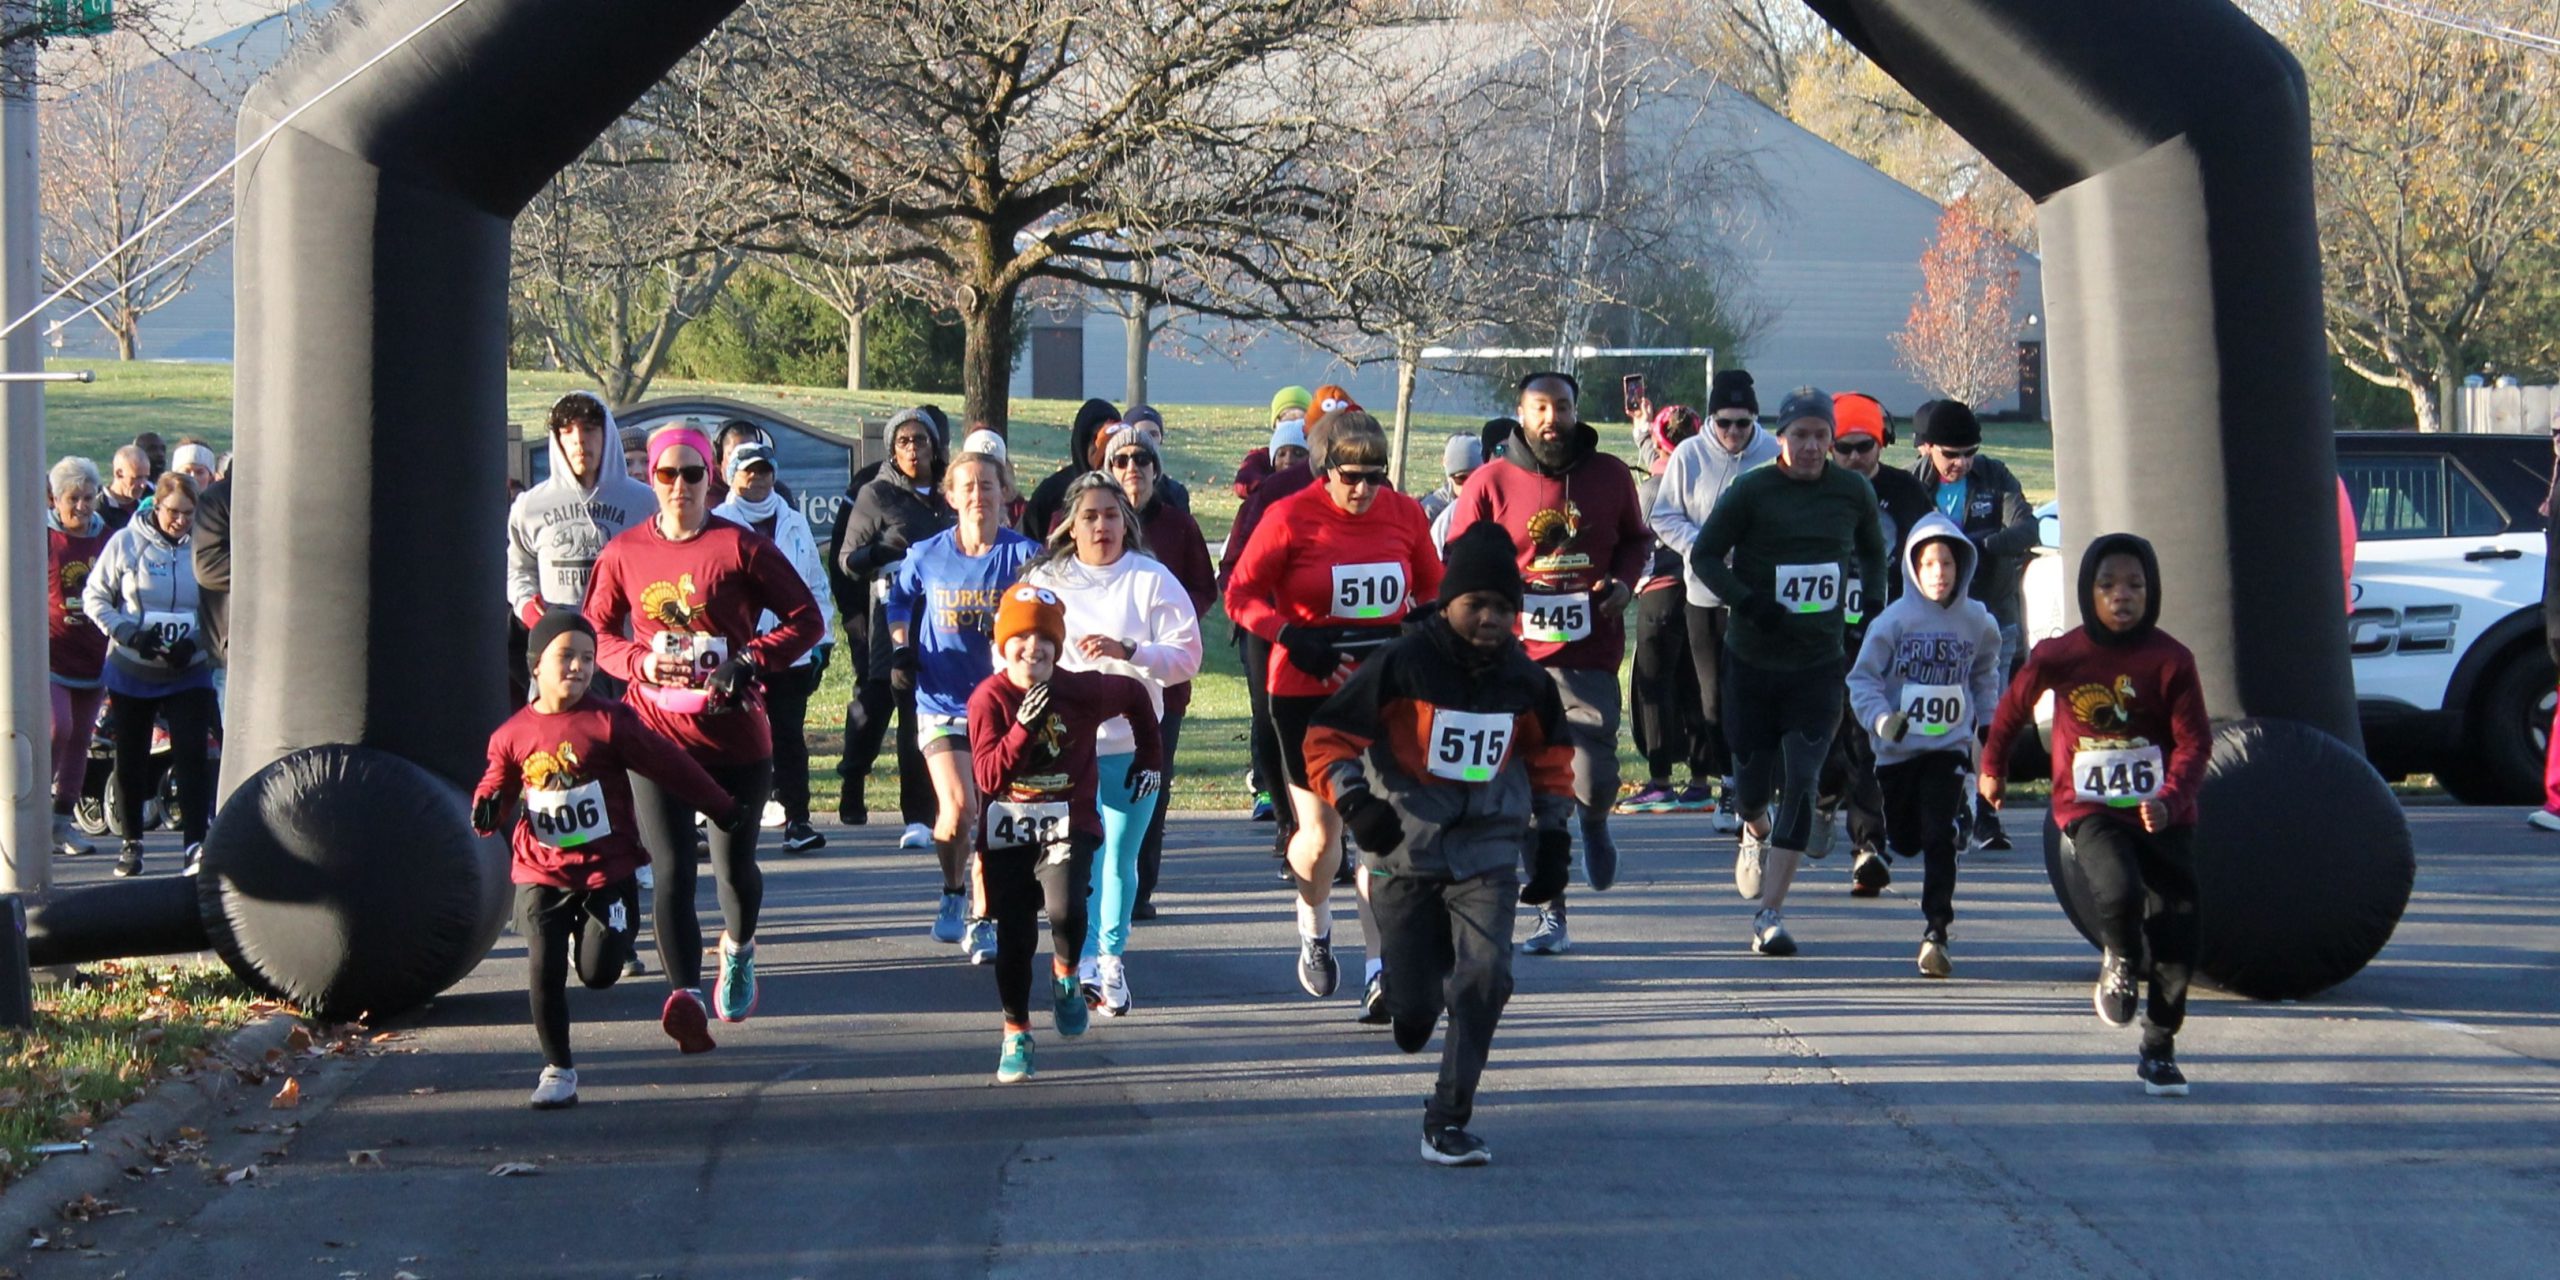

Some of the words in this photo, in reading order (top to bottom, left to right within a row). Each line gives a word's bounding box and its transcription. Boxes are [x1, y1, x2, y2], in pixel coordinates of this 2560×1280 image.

[543, 502, 626, 526] CALIFORNIA
[1340, 575, 1399, 607] 510
[1782, 575, 1834, 602] 476
[1530, 604, 1584, 631] 445
[1900, 640, 1959, 661] CROSS
[1907, 696, 1960, 724] 490
[1439, 726, 1505, 766] 515
[2084, 760, 2155, 796] 446
[538, 798, 599, 835] 406
[994, 815, 1059, 846] 438
